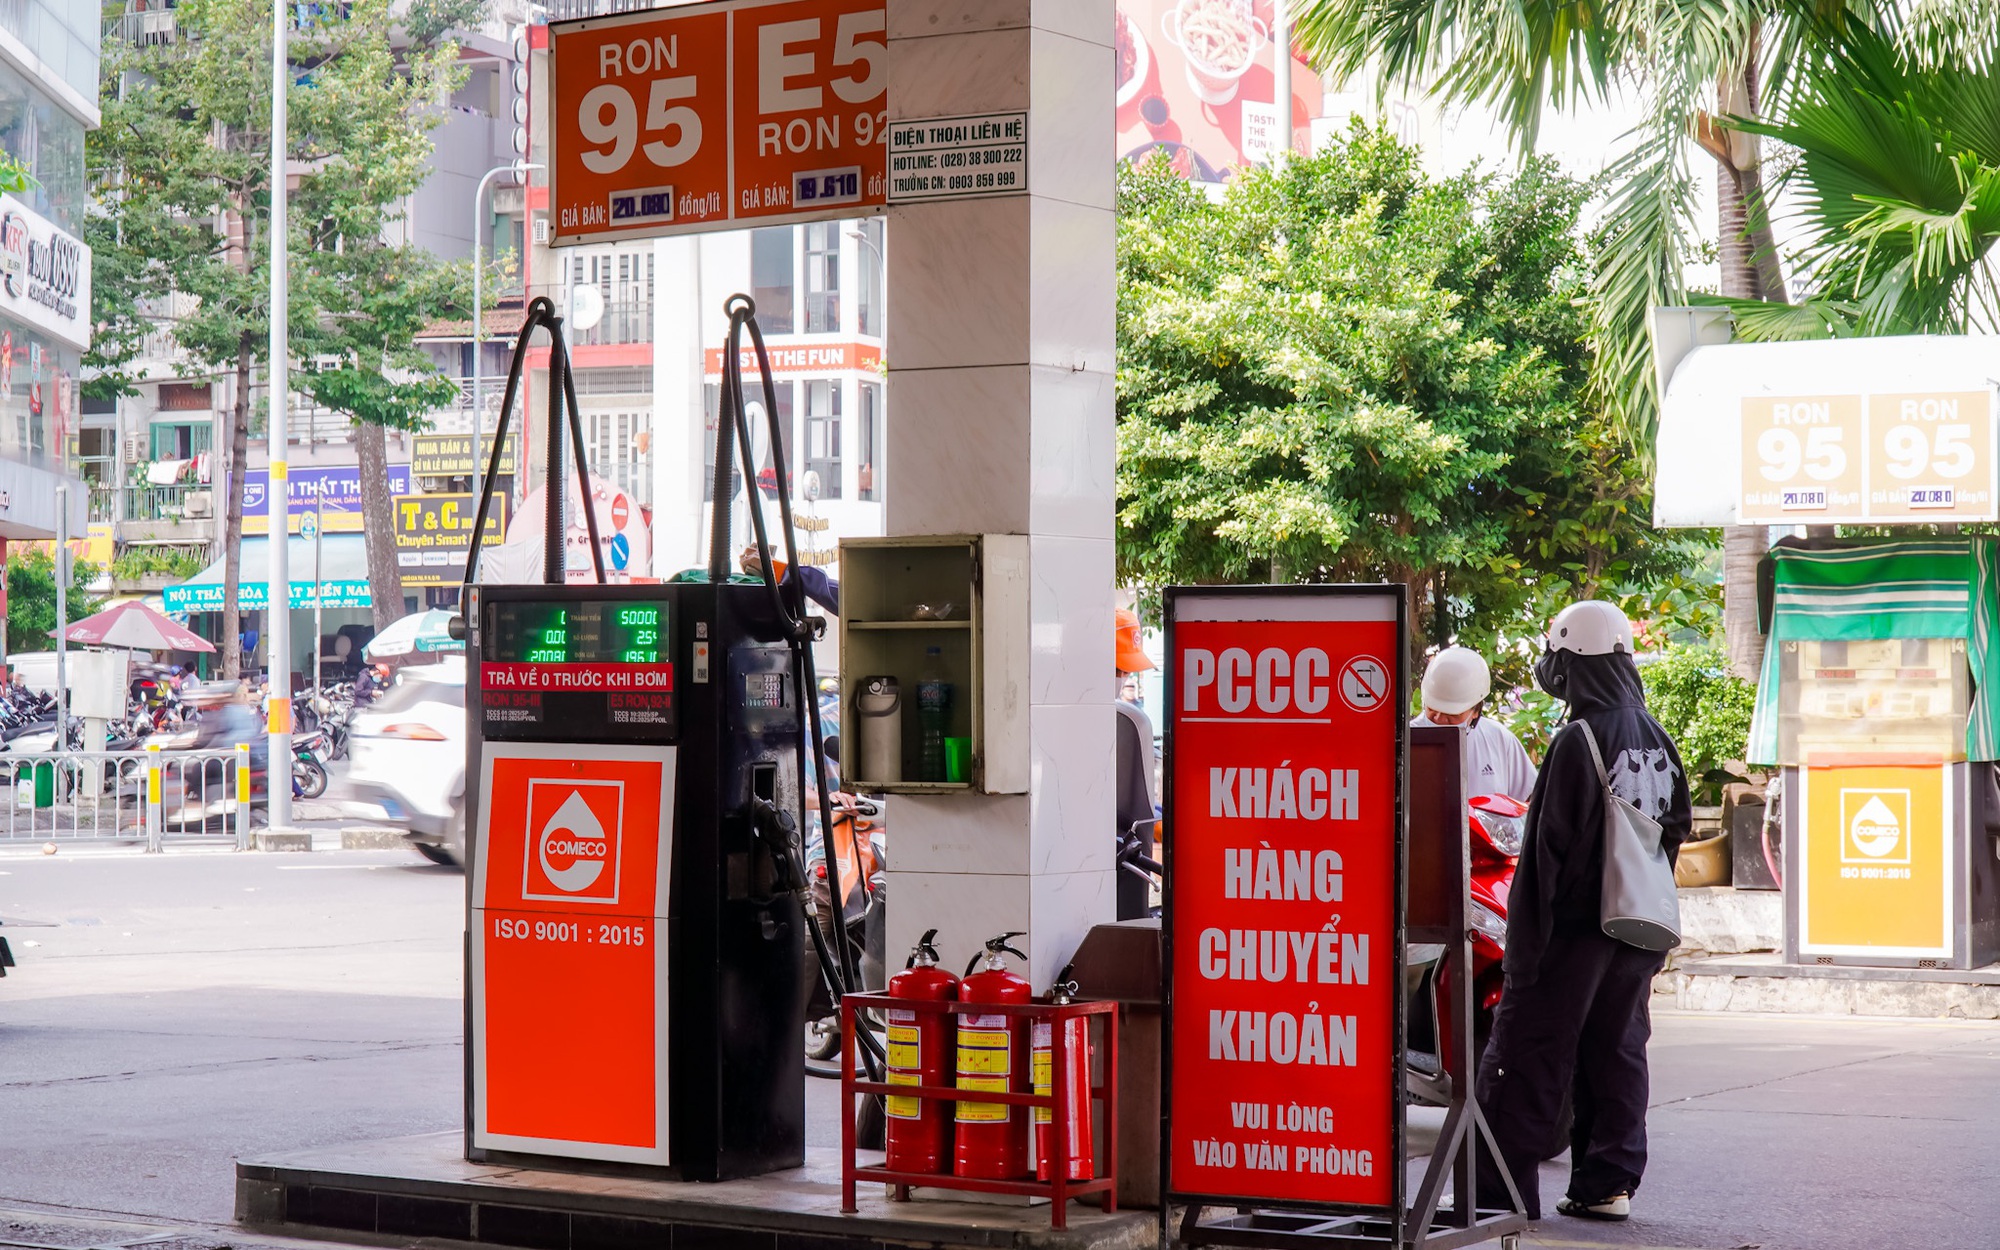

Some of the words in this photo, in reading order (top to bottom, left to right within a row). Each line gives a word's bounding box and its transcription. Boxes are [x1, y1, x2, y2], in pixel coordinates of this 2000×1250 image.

[600, 34, 678, 79] RON
[758, 8, 888, 115] E5
[578, 75, 703, 174] 95
[758, 115, 840, 157] RON
[854, 111, 888, 147] 92
[894, 127, 925, 148] ĐIỆN
[929, 126, 967, 145] THOẠI
[971, 121, 1000, 140] LIÊN
[1005, 119, 1022, 140] HỆ
[1248, 126, 1266, 137] THE
[1248, 138, 1266, 149] FUN
[894, 155, 937, 171] HOTLINE:
[940, 152, 967, 168] (028)
[969, 152, 981, 165] 38
[983, 150, 1001, 164] 300
[1003, 148, 1022, 163] 222
[894, 173, 929, 192] TRƯỞNG
[931, 176, 946, 189] CN:
[949, 175, 973, 189] 0903
[742, 185, 760, 209] GIÁ
[763, 182, 790, 206] BÁN:
[561, 205, 579, 228] GIÁ
[582, 202, 606, 225] BÁN:
[679, 191, 721, 220] đồng/lít
[4, 222, 23, 257] KFC
[773, 350, 806, 366] THE
[808, 348, 844, 365] FUN
[1773, 402, 1830, 425] RON
[1901, 399, 1958, 421] RON
[417, 441, 438, 455] MUA
[440, 439, 460, 454] BÁN
[463, 441, 470, 453] &
[1757, 427, 1847, 482] 95
[1884, 424, 1975, 479] 95
[422, 458, 431, 471] VÀ
[432, 457, 440, 470] LẺ
[441, 458, 458, 471] MÀN
[298, 476, 338, 496] THẤT
[1783, 492, 1824, 505] 20.080
[1911, 490, 1951, 503] 20.080
[401, 503, 421, 530] T
[424, 511, 438, 530] &
[441, 502, 458, 530] C
[396, 534, 434, 549] Chuyên
[436, 534, 467, 545] Smart
[169, 588, 192, 602] NỘI
[488, 667, 516, 686] TRẢ
[519, 666, 538, 686] VỀ
[541, 672, 550, 687] 0
[553, 670, 603, 687] TRƯỚC
[606, 672, 631, 687] KHI
[634, 671, 667, 687] BƠM
[1183, 647, 1330, 714] PCCC
[482, 693, 510, 708] RON
[611, 694, 624, 708] E5
[626, 694, 649, 708] RON
[1209, 760, 1359, 820] KHÁCH
[546, 840, 607, 857] COMECO
[1225, 840, 1343, 903] HÀNG
[1841, 867, 1859, 879] ISO
[494, 918, 530, 939] ISO
[535, 921, 578, 942] 9001
[599, 924, 645, 946] 2015
[1198, 913, 1369, 985] CHUYỂN
[1209, 1000, 1357, 1067] KHOẢN
[1231, 1101, 1269, 1130] VUI
[1276, 1101, 1333, 1133] LÒNG
[1193, 1136, 1237, 1168] VÀO
[1243, 1140, 1288, 1172] VĂN
[1295, 1144, 1373, 1177] PHÒNG
